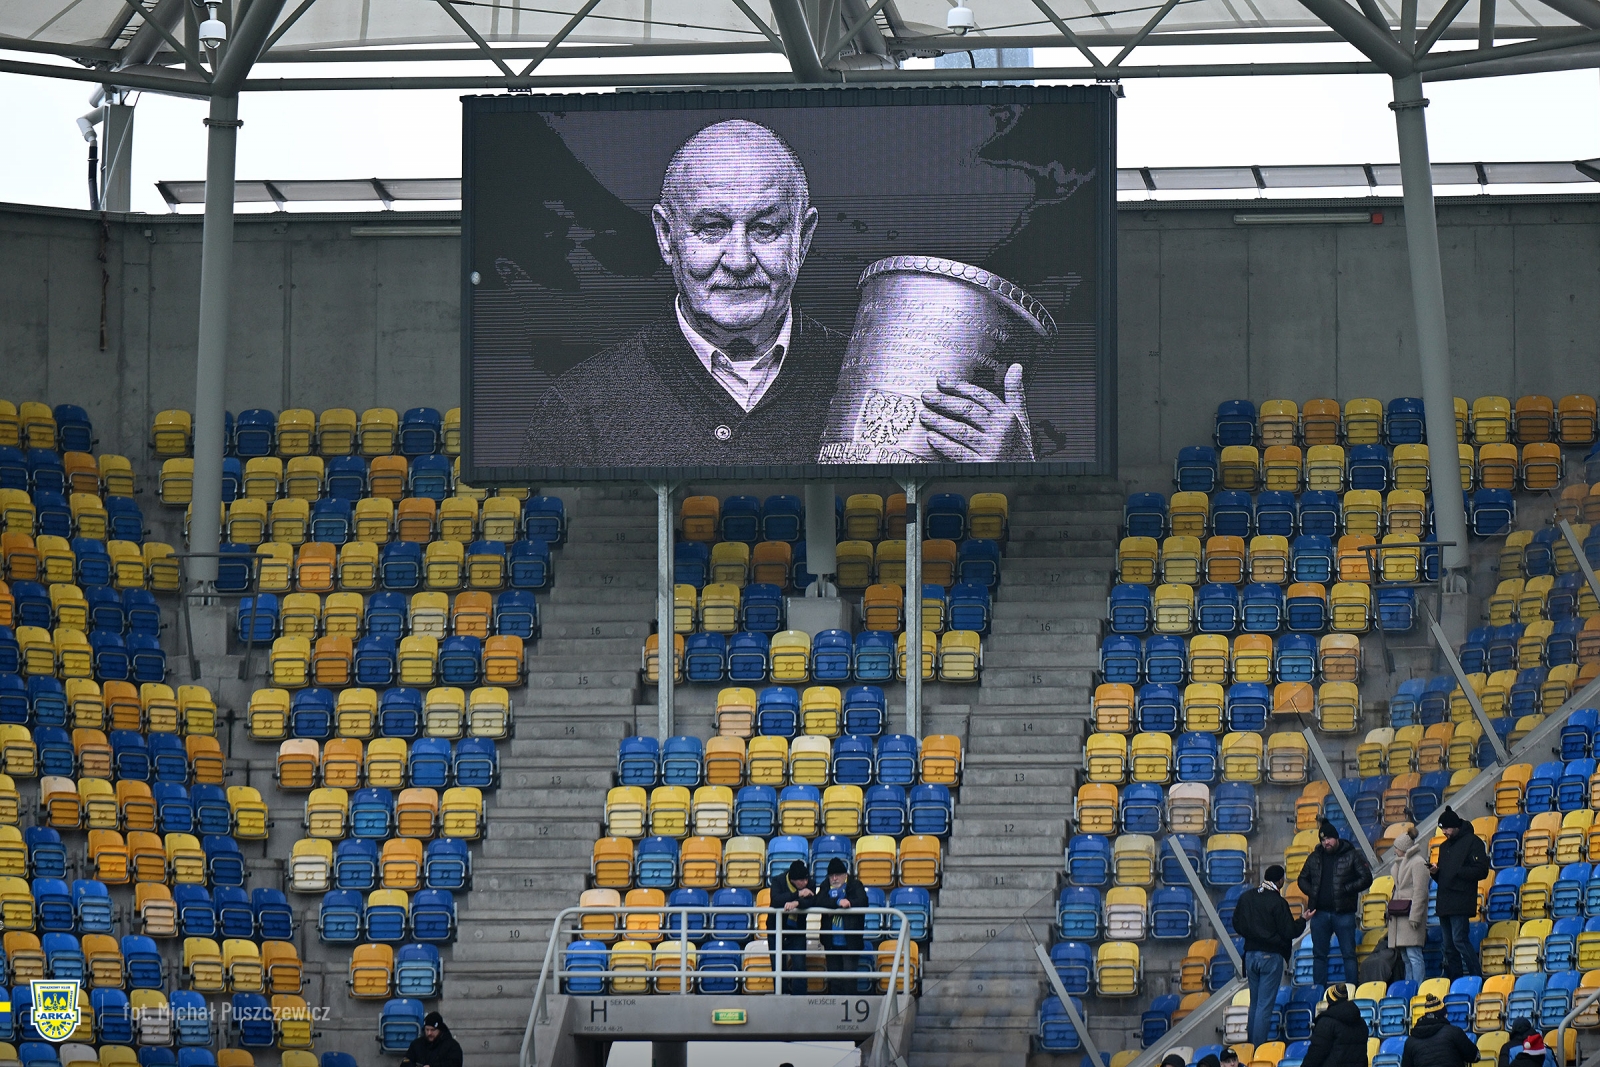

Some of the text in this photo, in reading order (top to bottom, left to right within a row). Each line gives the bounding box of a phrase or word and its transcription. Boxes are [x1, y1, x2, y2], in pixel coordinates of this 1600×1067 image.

[616, 533, 625, 541] 18
[1050, 574, 1060, 582] 17
[591, 626, 600, 636] 16
[1040, 622, 1050, 632] 16
[578, 676, 588, 686] 15
[1032, 676, 1042, 684] 15
[564, 726, 574, 736] 14
[1023, 723, 1032, 731] 14
[551, 776, 562, 785] 13
[1014, 772, 1024, 782] 13
[538, 826, 548, 836] 12
[1004, 824, 1014, 833] 12
[524, 878, 534, 888] 11
[994, 876, 1004, 886] 11
[510, 930, 520, 938] 10
[986, 929, 996, 938] 10
[497, 985, 503, 994] 9
[808, 997, 836, 1005] WEJŚCIE
[590, 1000, 607, 1023] H
[840, 999, 870, 1022] 19
[483, 1040, 489, 1049] 8
